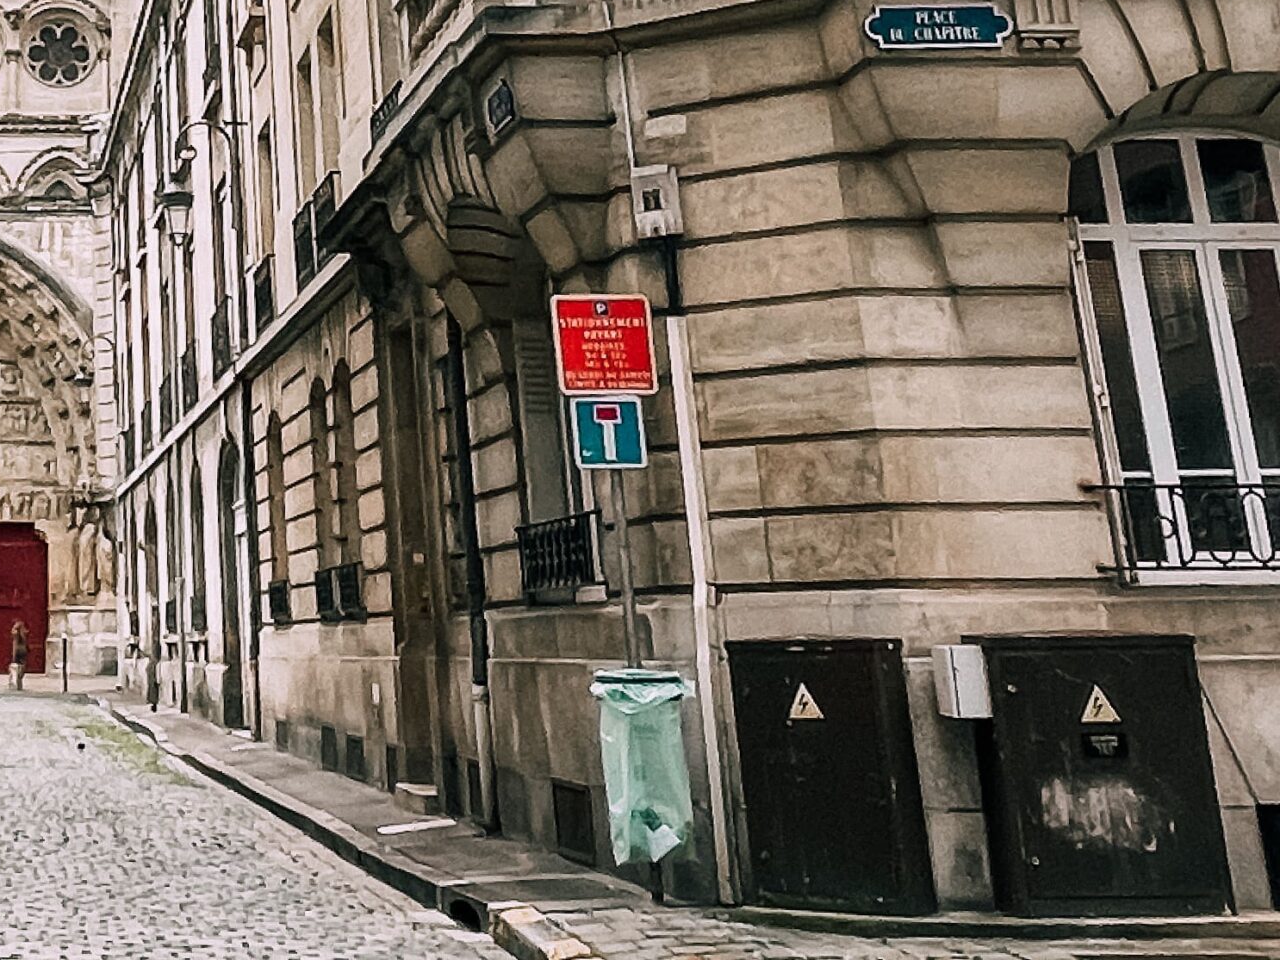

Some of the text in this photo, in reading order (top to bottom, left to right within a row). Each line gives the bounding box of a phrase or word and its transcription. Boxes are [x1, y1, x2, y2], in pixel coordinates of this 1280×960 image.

[915, 10, 958, 24] PLACE
[890, 26, 982, 41] DU CHAPITRE
